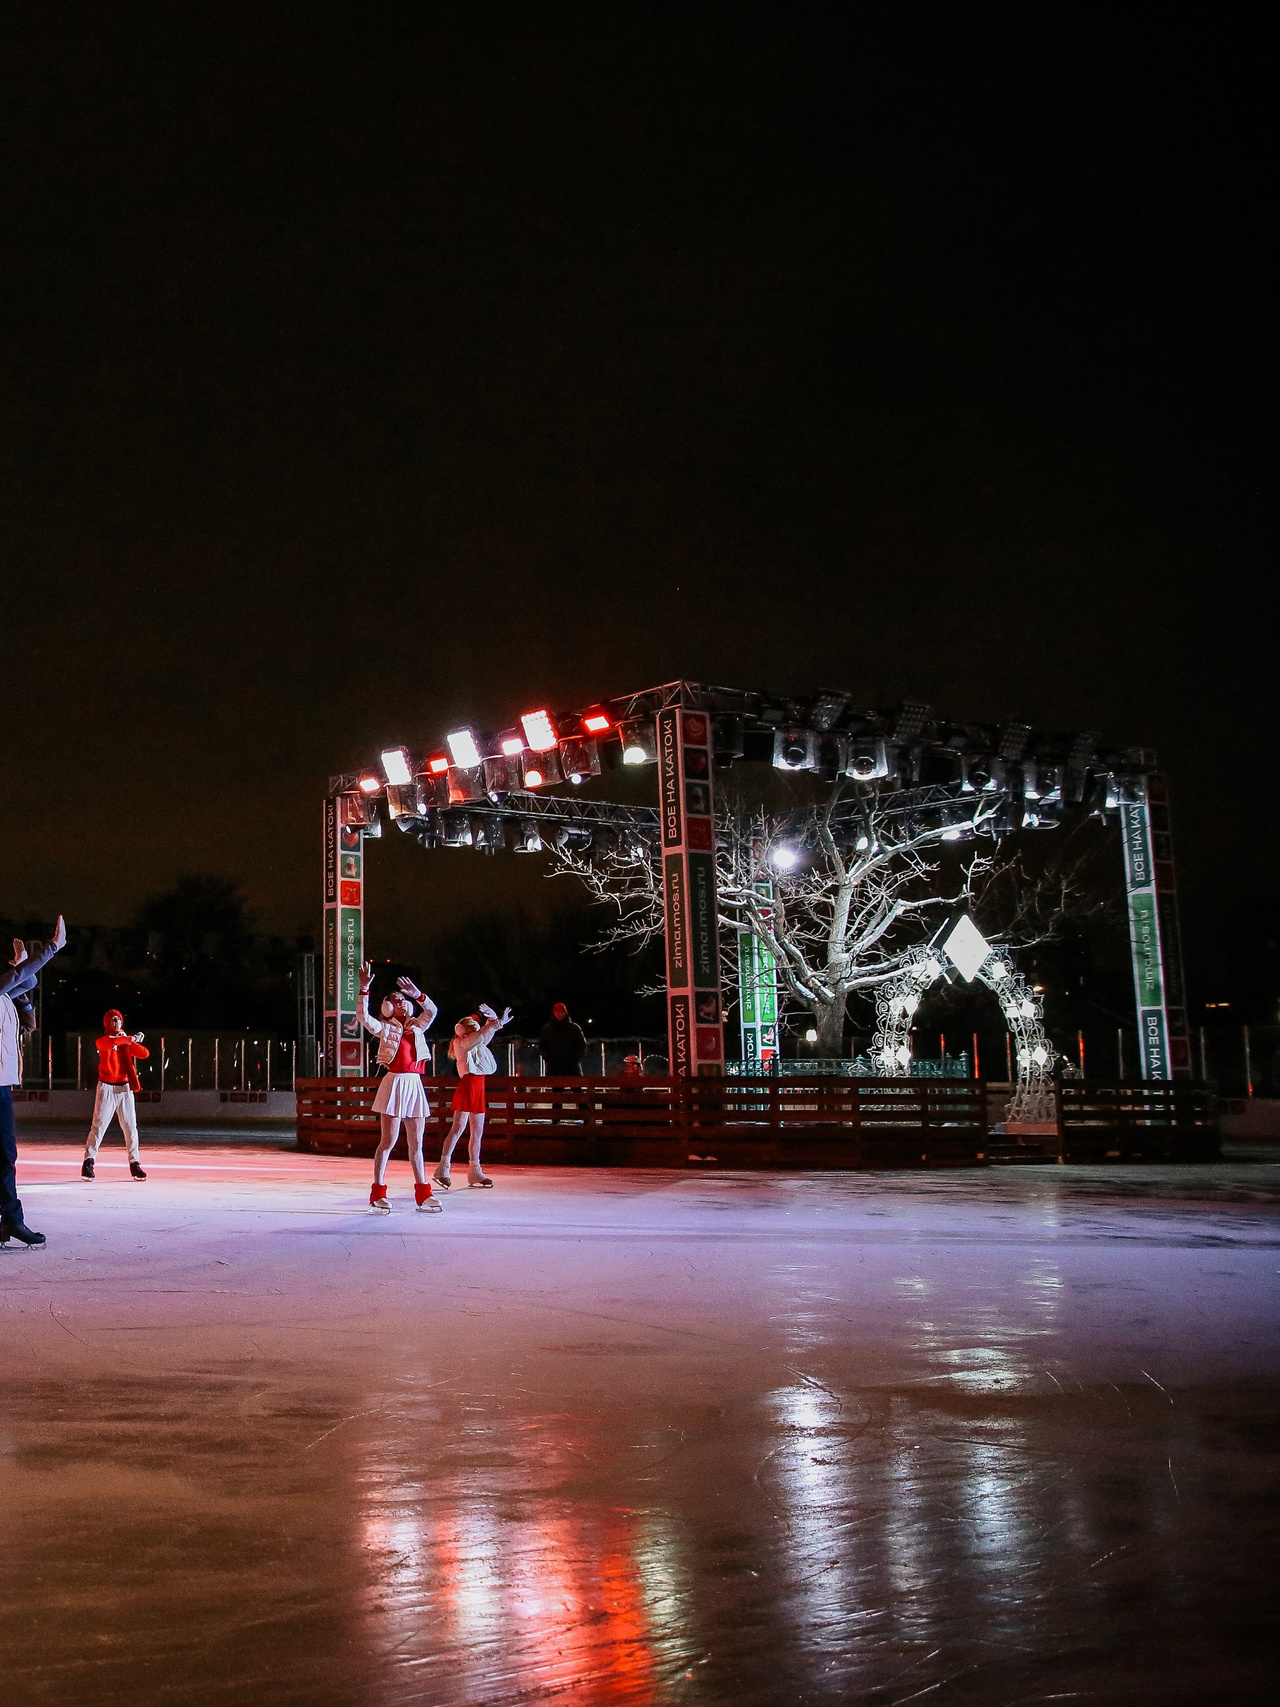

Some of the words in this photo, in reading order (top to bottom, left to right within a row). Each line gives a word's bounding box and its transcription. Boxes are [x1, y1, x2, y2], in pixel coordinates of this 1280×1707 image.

[664, 719, 674, 777] КАТОК!
[666, 779, 676, 802] НА
[668, 805, 677, 839] ВСЕ
[1133, 829, 1143, 850] НА
[328, 848, 335, 867] НА
[1134, 852, 1145, 881] ВСЕ
[671, 873, 683, 969] zima.mos.ru
[697, 866, 710, 975] zima.mos.ru
[346, 918, 355, 1001] zima.mos.ru
[676, 1003, 686, 1063] КАТОК!
[1147, 1016, 1159, 1045] ВСЕ
[1149, 1048, 1161, 1068] НА
